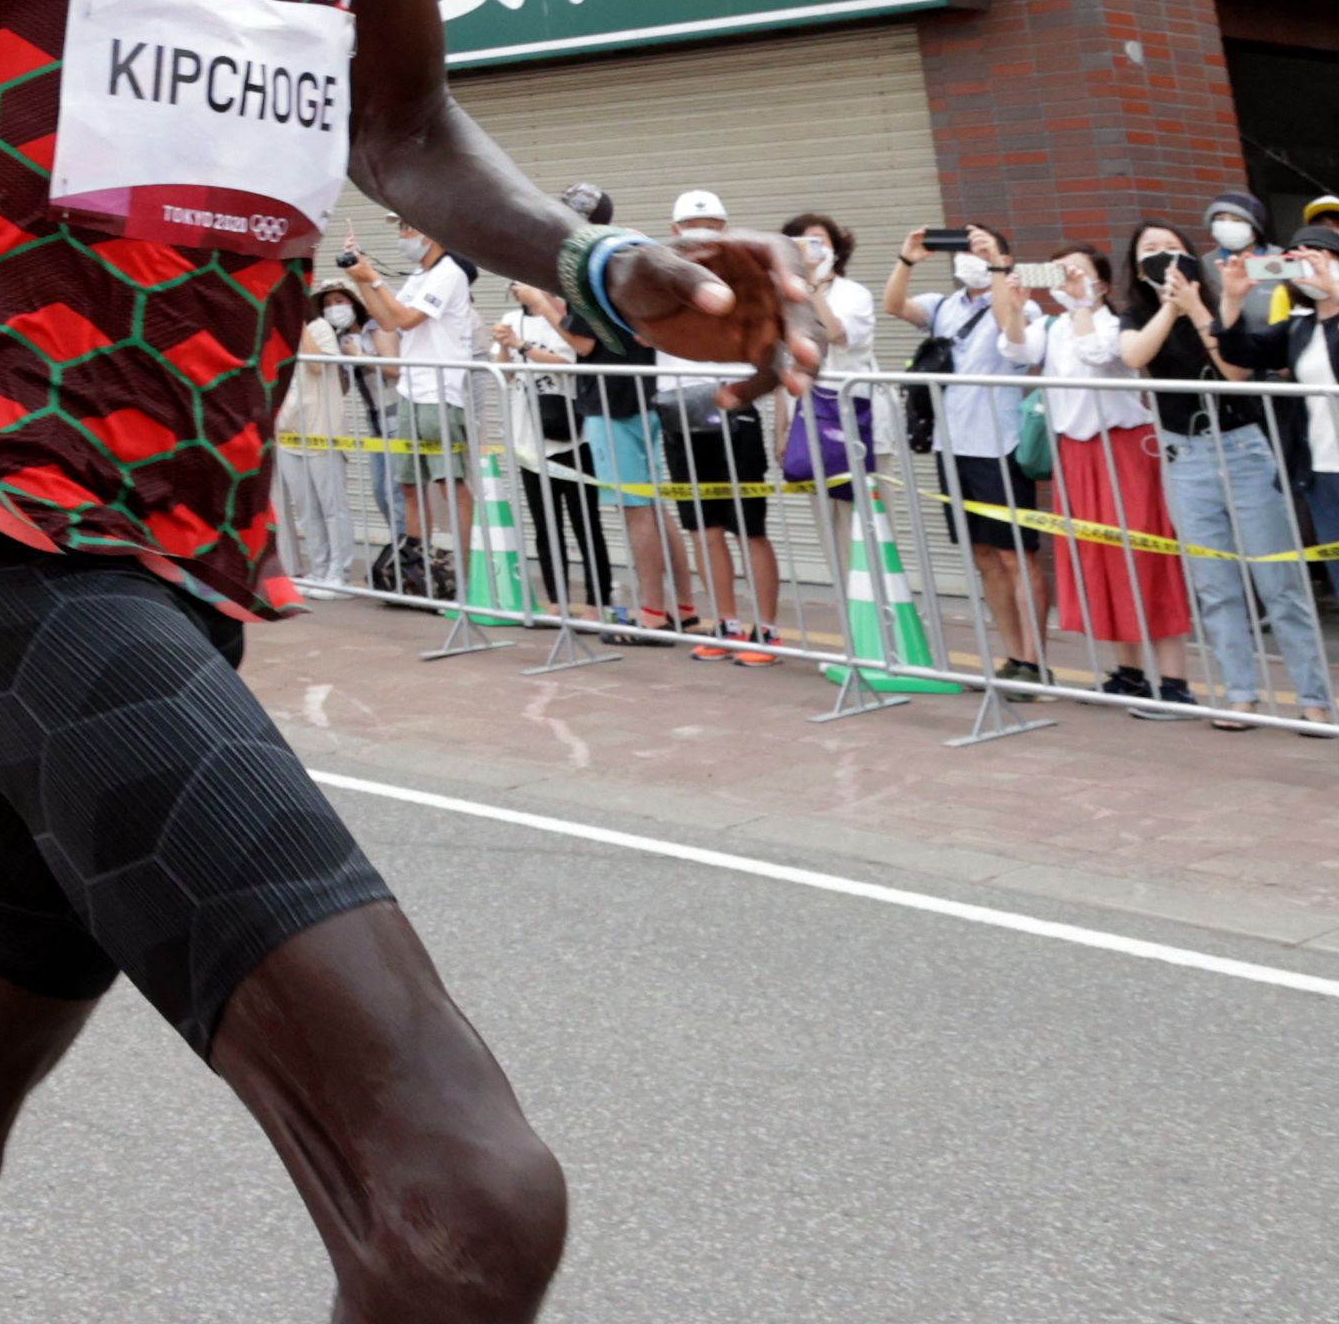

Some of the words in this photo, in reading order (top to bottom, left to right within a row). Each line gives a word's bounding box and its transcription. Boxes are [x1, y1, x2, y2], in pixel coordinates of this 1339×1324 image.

[108, 38, 337, 131] KIPCHOGE
[162, 205, 214, 228] TOKYO
[213, 213, 248, 233] 2020
